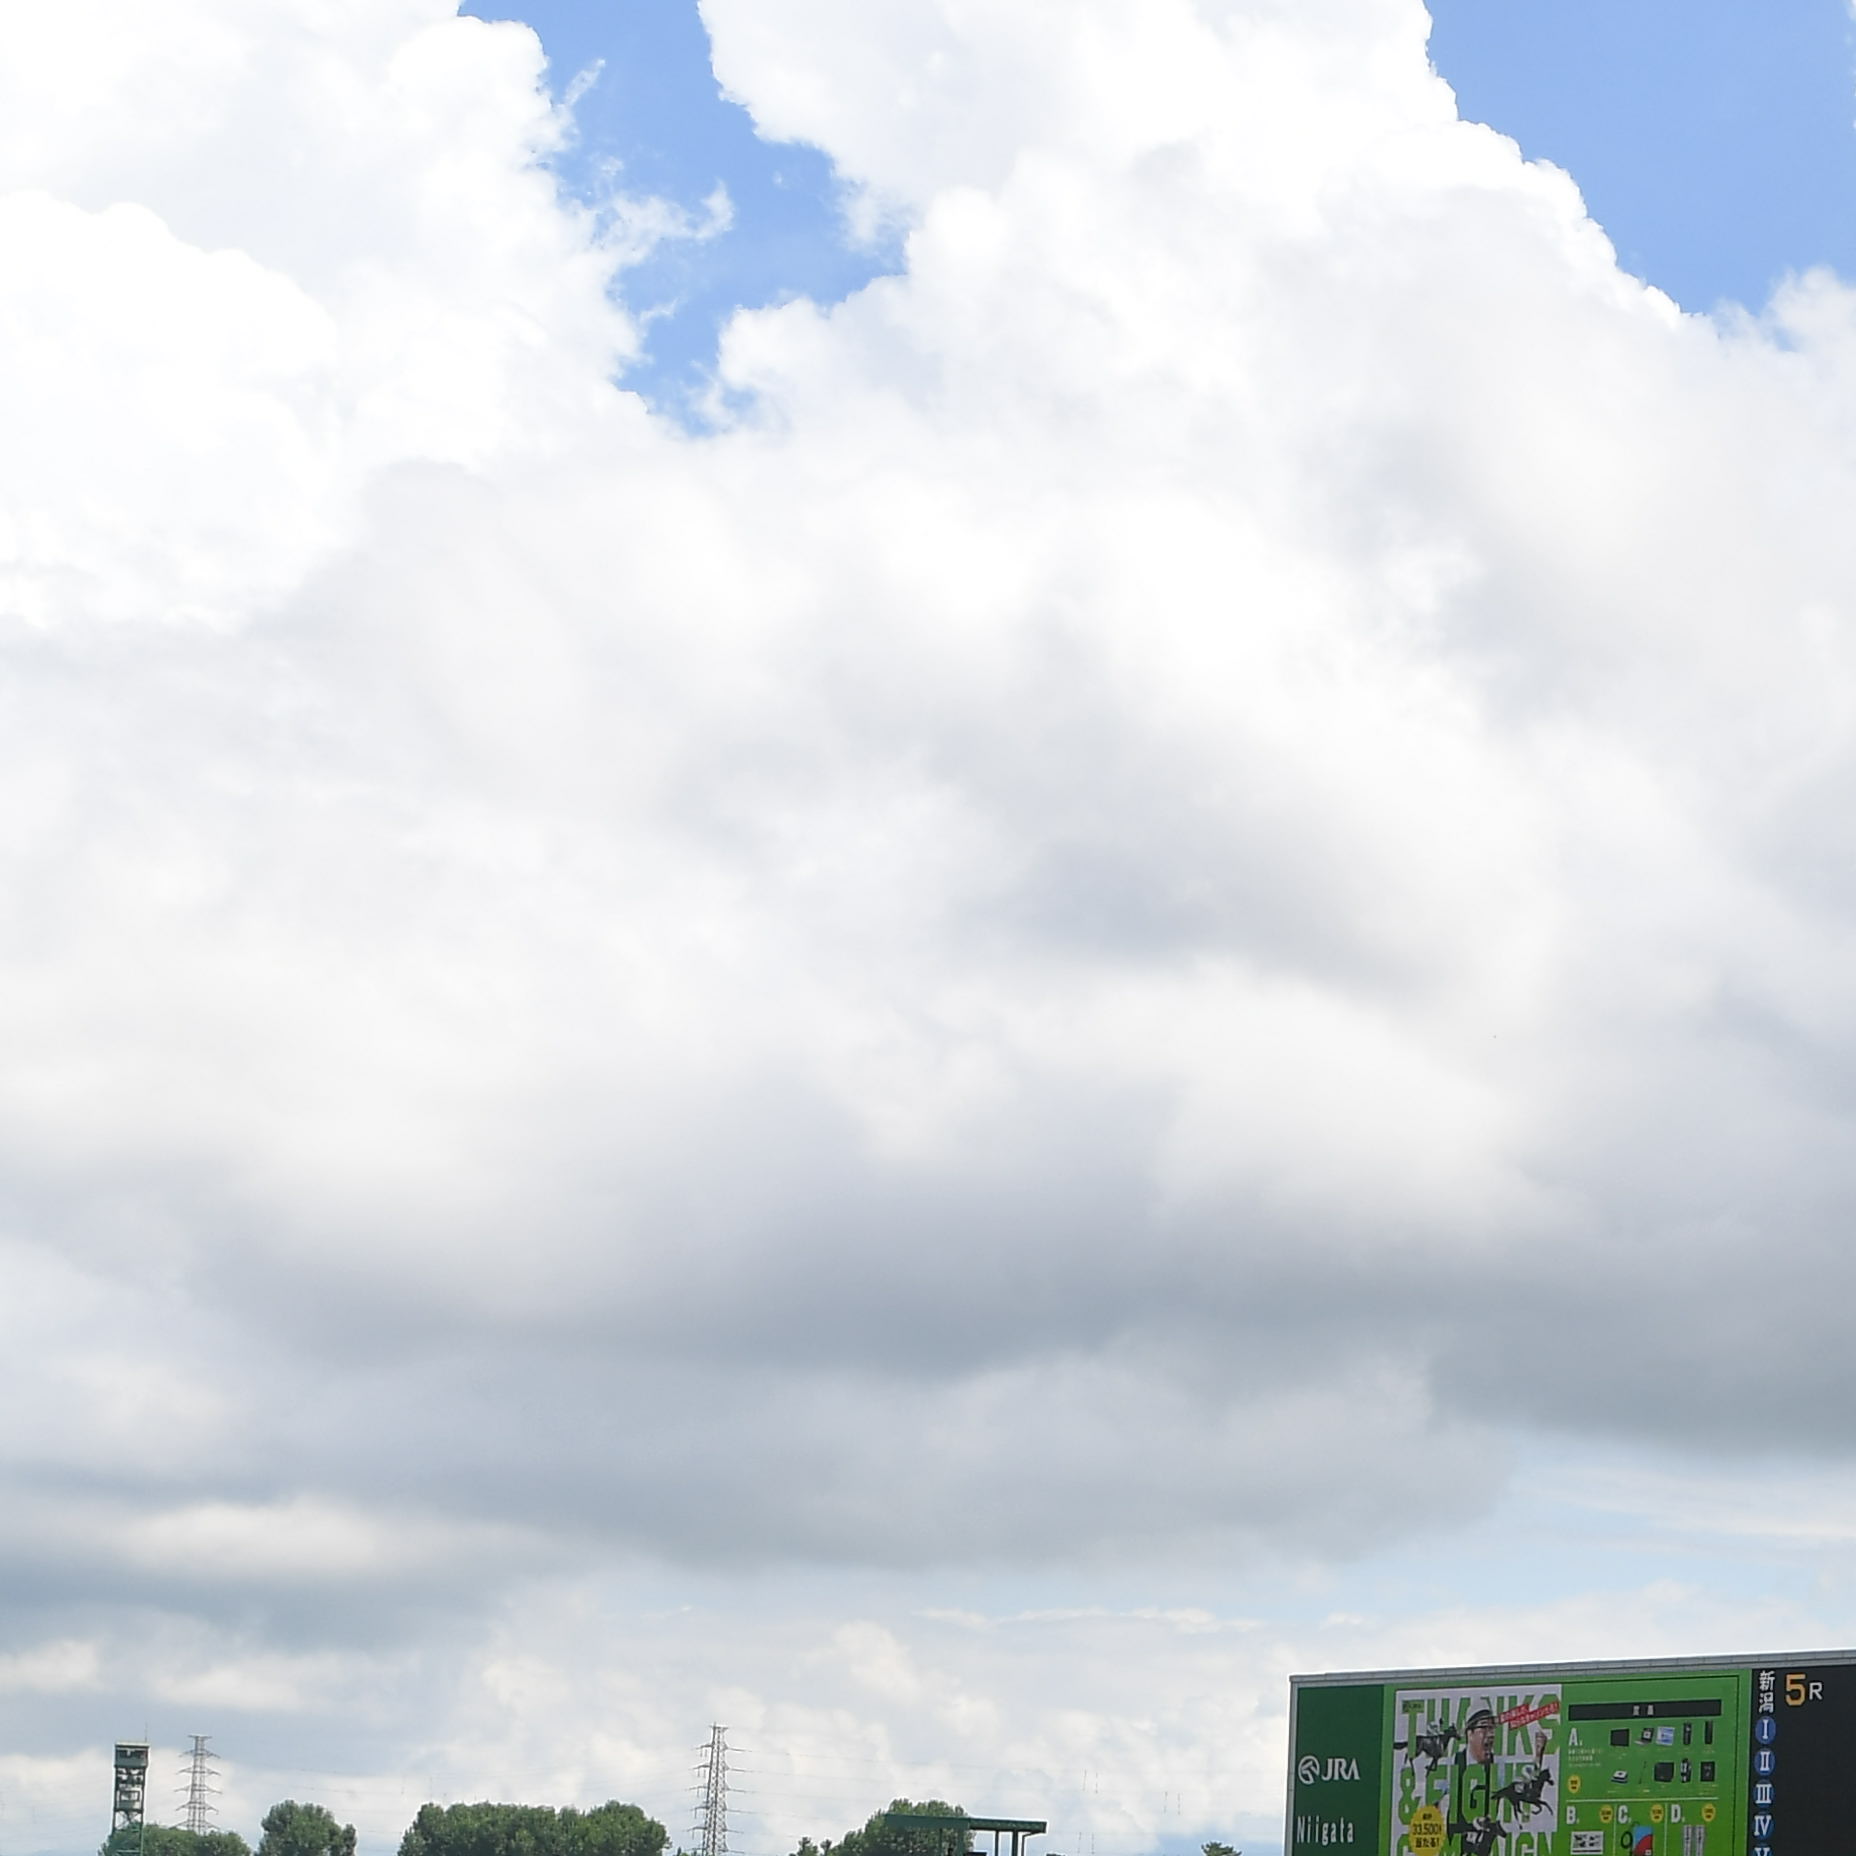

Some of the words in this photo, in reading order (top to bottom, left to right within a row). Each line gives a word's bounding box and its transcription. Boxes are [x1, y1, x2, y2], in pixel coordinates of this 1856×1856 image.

[1758, 1670, 1775, 1713] 新潟
[1322, 1757, 1360, 1781] JRA
[1296, 1815, 1354, 1846] Niigata
